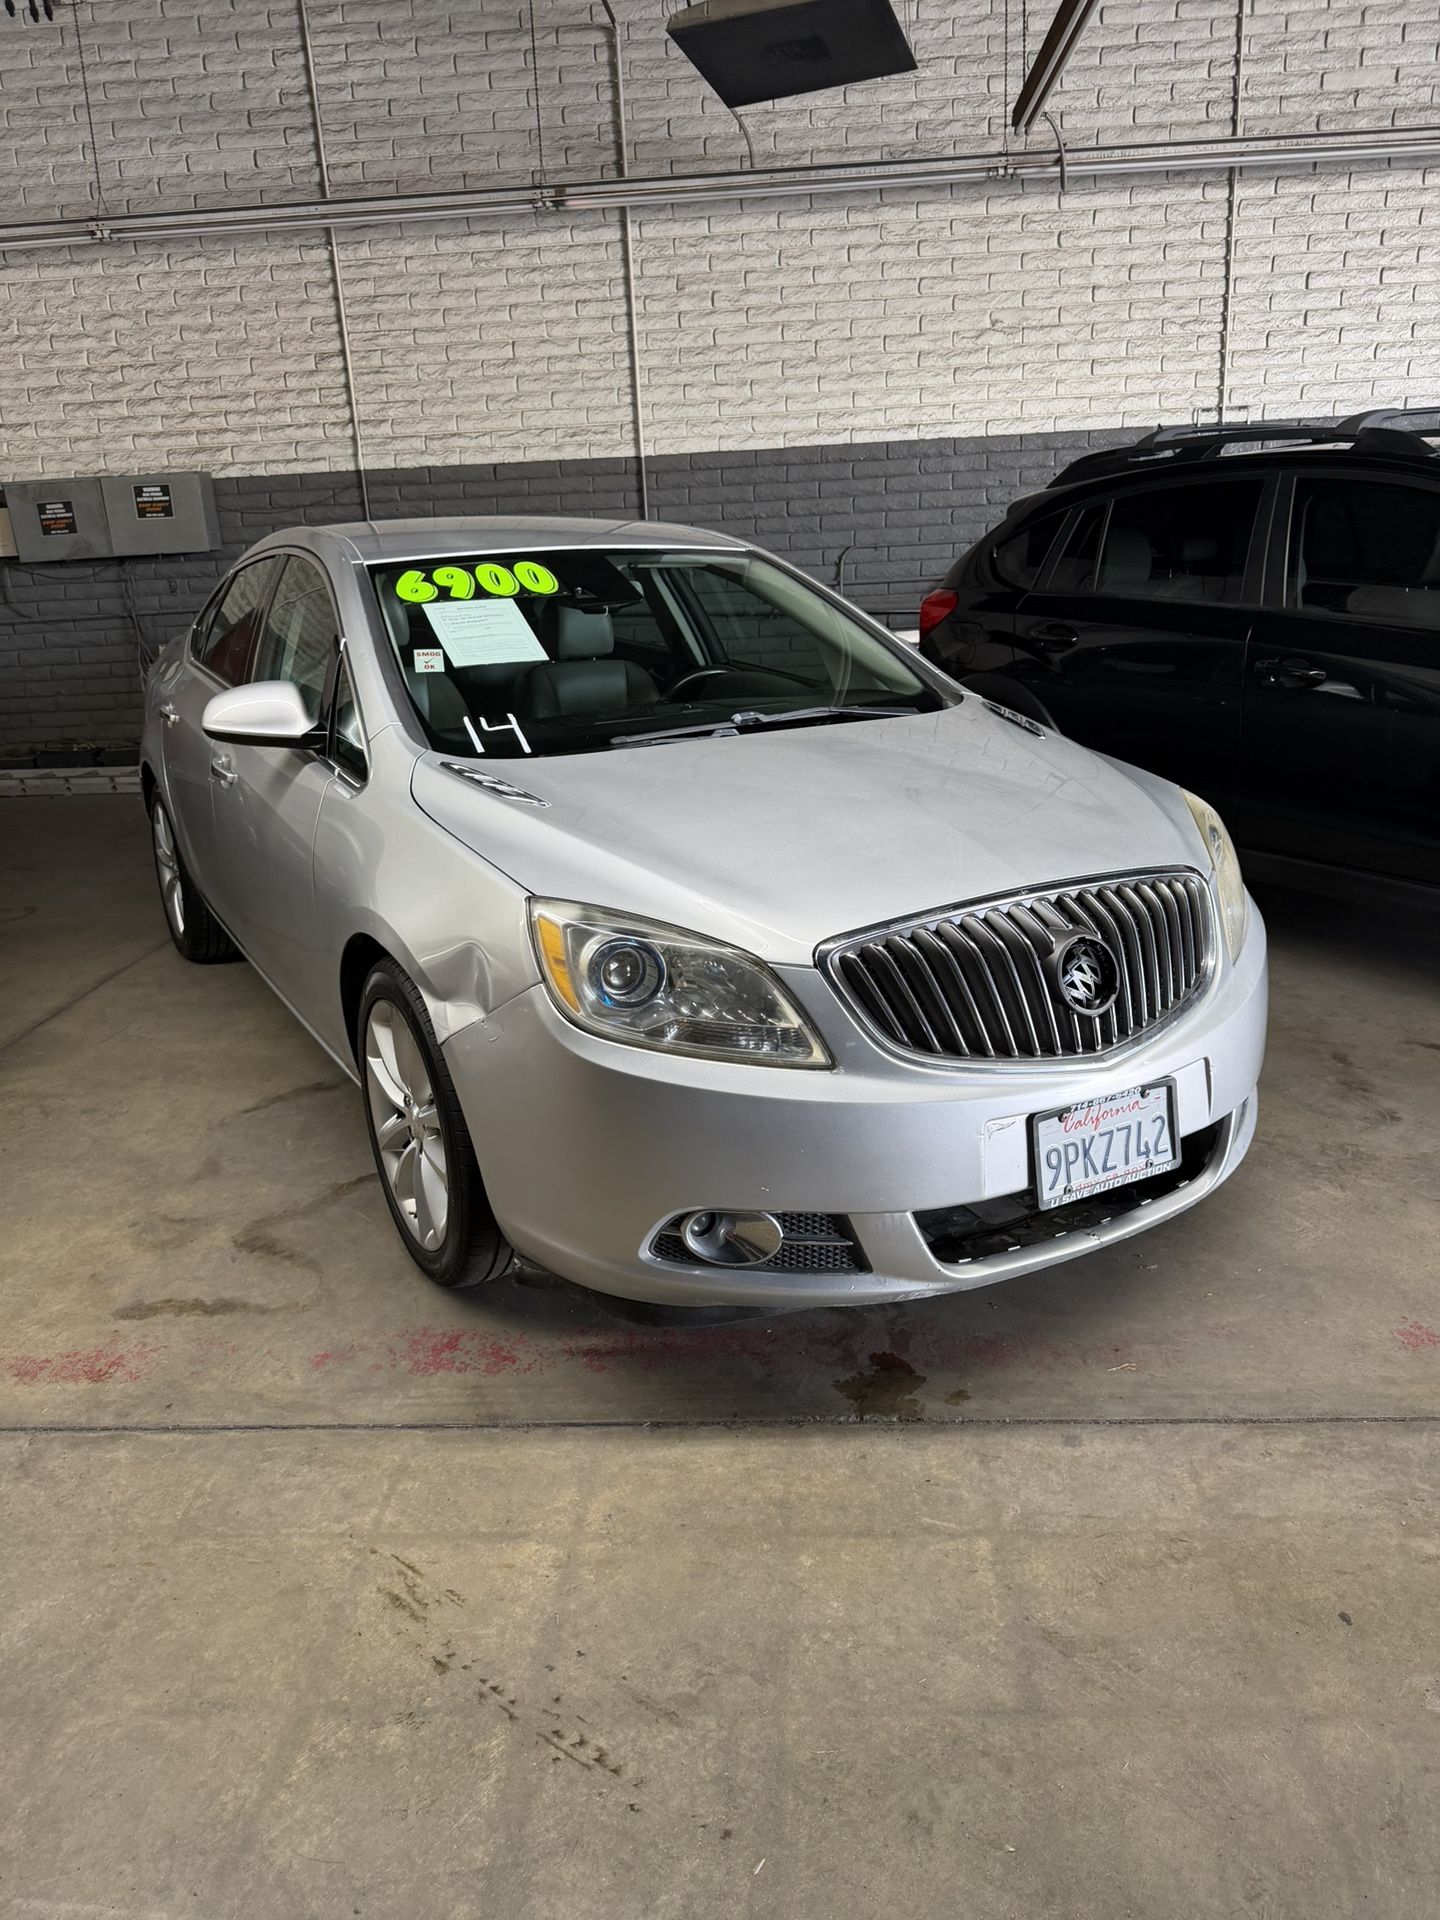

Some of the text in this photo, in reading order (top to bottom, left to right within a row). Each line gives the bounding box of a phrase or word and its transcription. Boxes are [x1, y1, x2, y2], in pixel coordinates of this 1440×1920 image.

[395, 560, 559, 603] 6900
[463, 712, 532, 754] 14
[1064, 1099, 1148, 1133] California
[1046, 1114, 1169, 1191] 9PKZ742
[1050, 1162, 1173, 1208] U SAVE AUTO AUCTION
